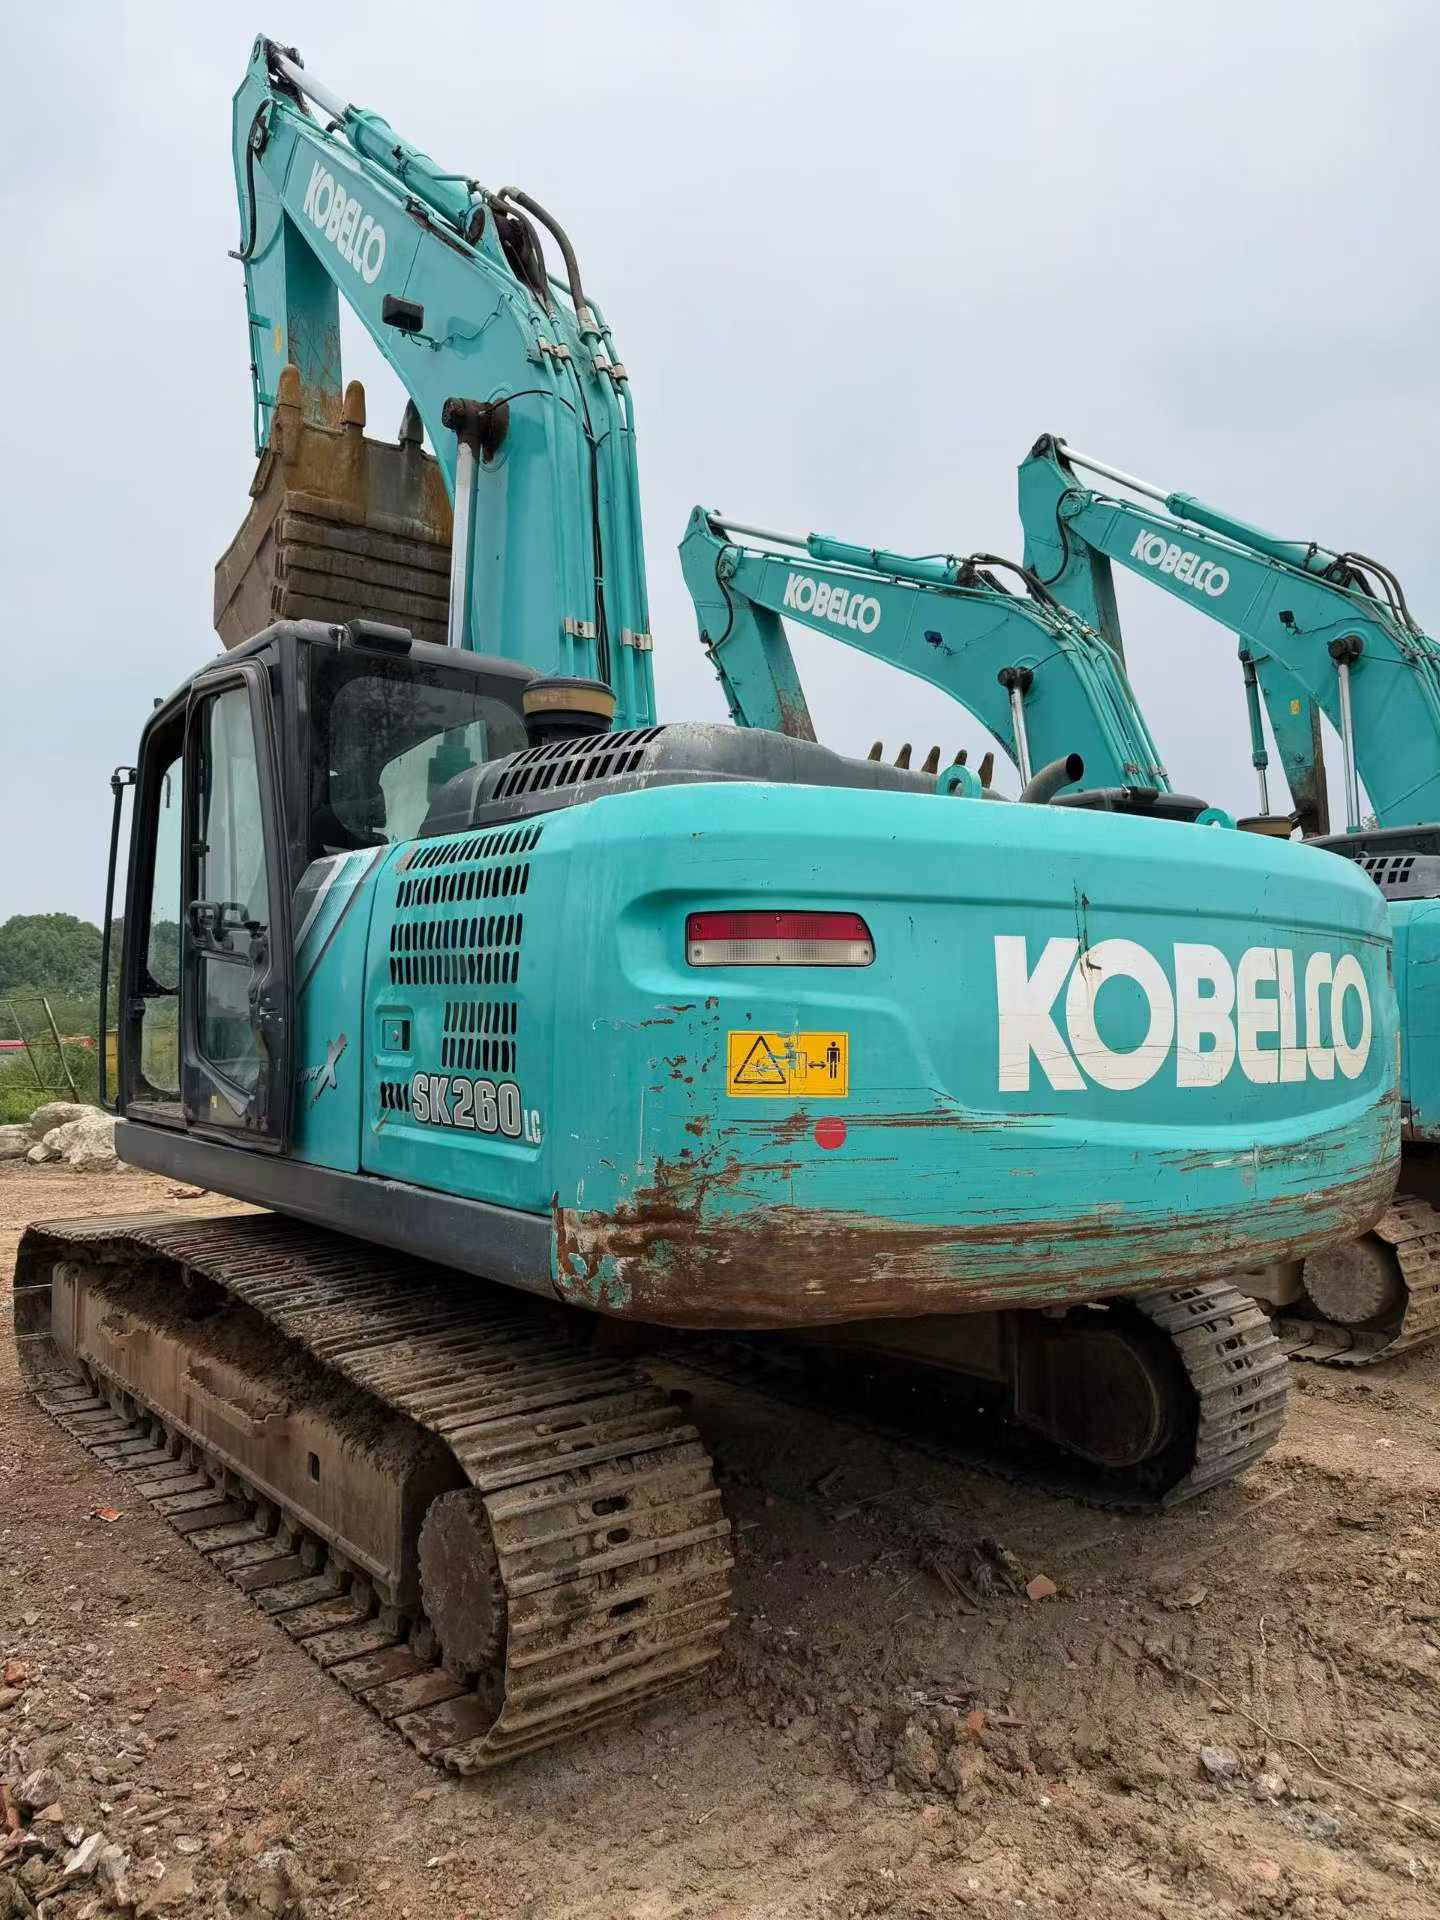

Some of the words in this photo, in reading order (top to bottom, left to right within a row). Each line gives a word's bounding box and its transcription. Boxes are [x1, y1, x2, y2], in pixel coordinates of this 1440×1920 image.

[303, 159, 386, 284] KOBELCO
[1129, 528, 1230, 597] KOBELCO
[783, 572, 881, 634] KOBELCO
[994, 935, 1372, 1092] KOBELCO
[411, 1070, 523, 1138] SK260
[523, 1108, 542, 1144] LC
